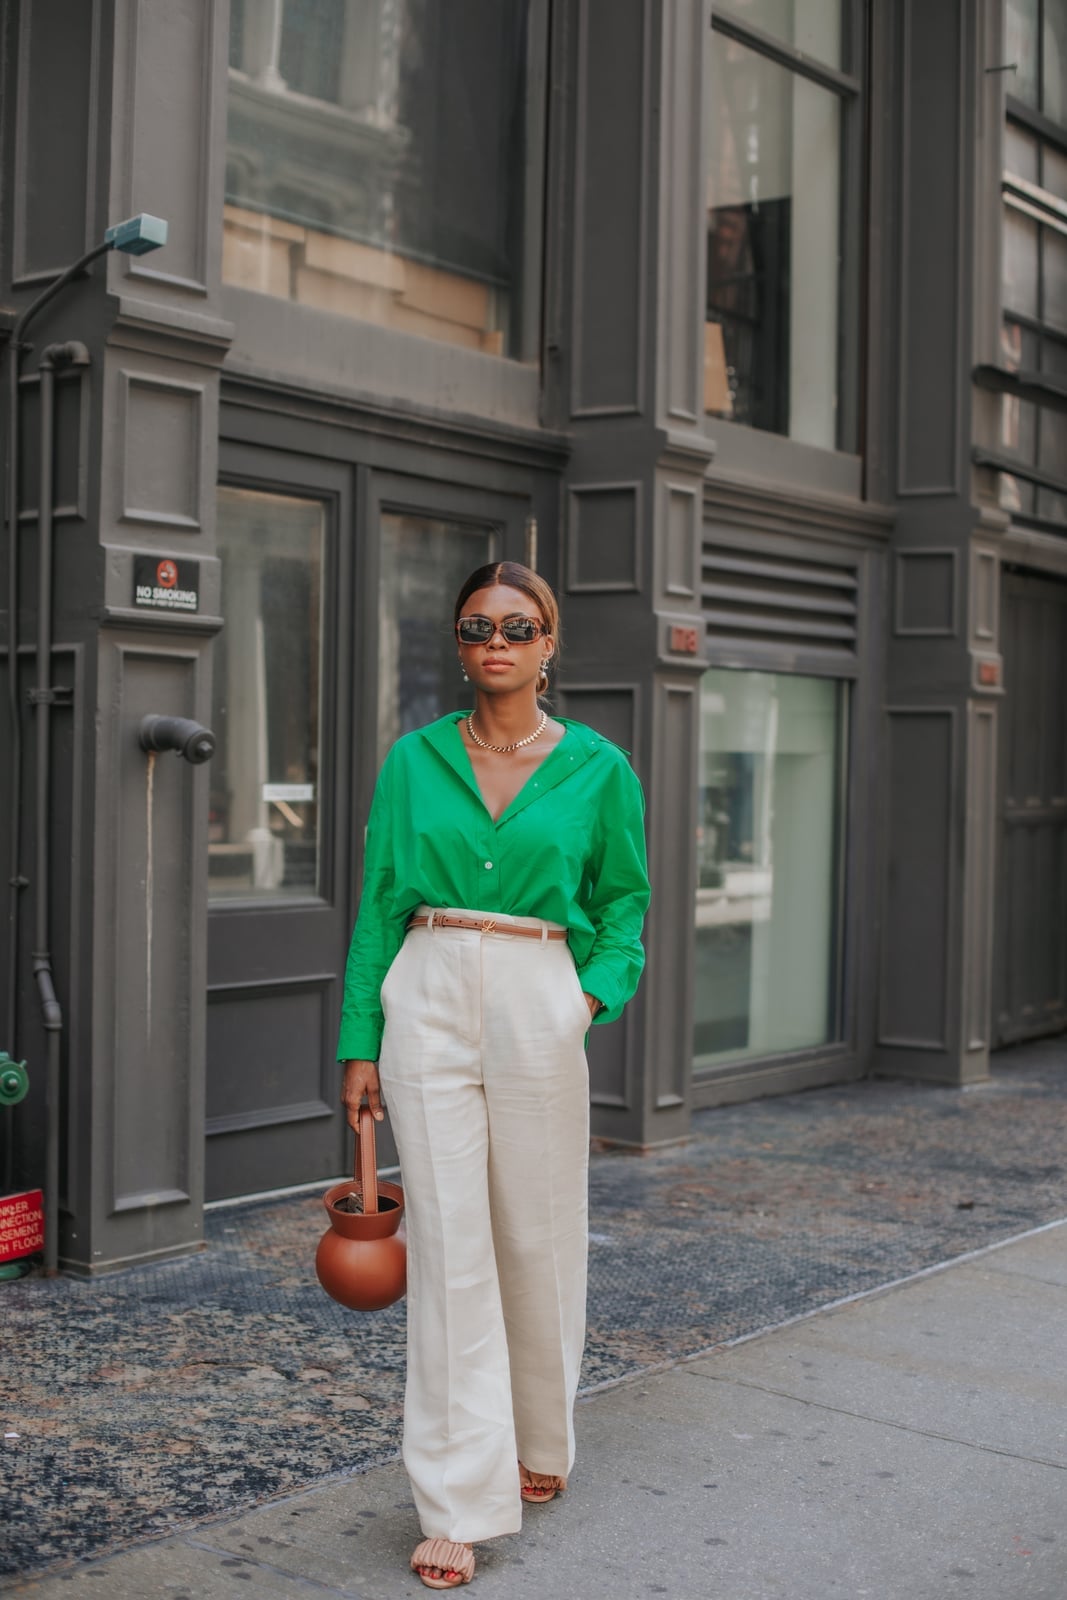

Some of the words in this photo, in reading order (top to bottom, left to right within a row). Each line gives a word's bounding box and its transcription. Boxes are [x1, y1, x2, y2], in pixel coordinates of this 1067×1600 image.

[136, 585, 152, 598] NO
[152, 587, 197, 603] SMOKING
[12, 1234, 44, 1251] FLOOR
